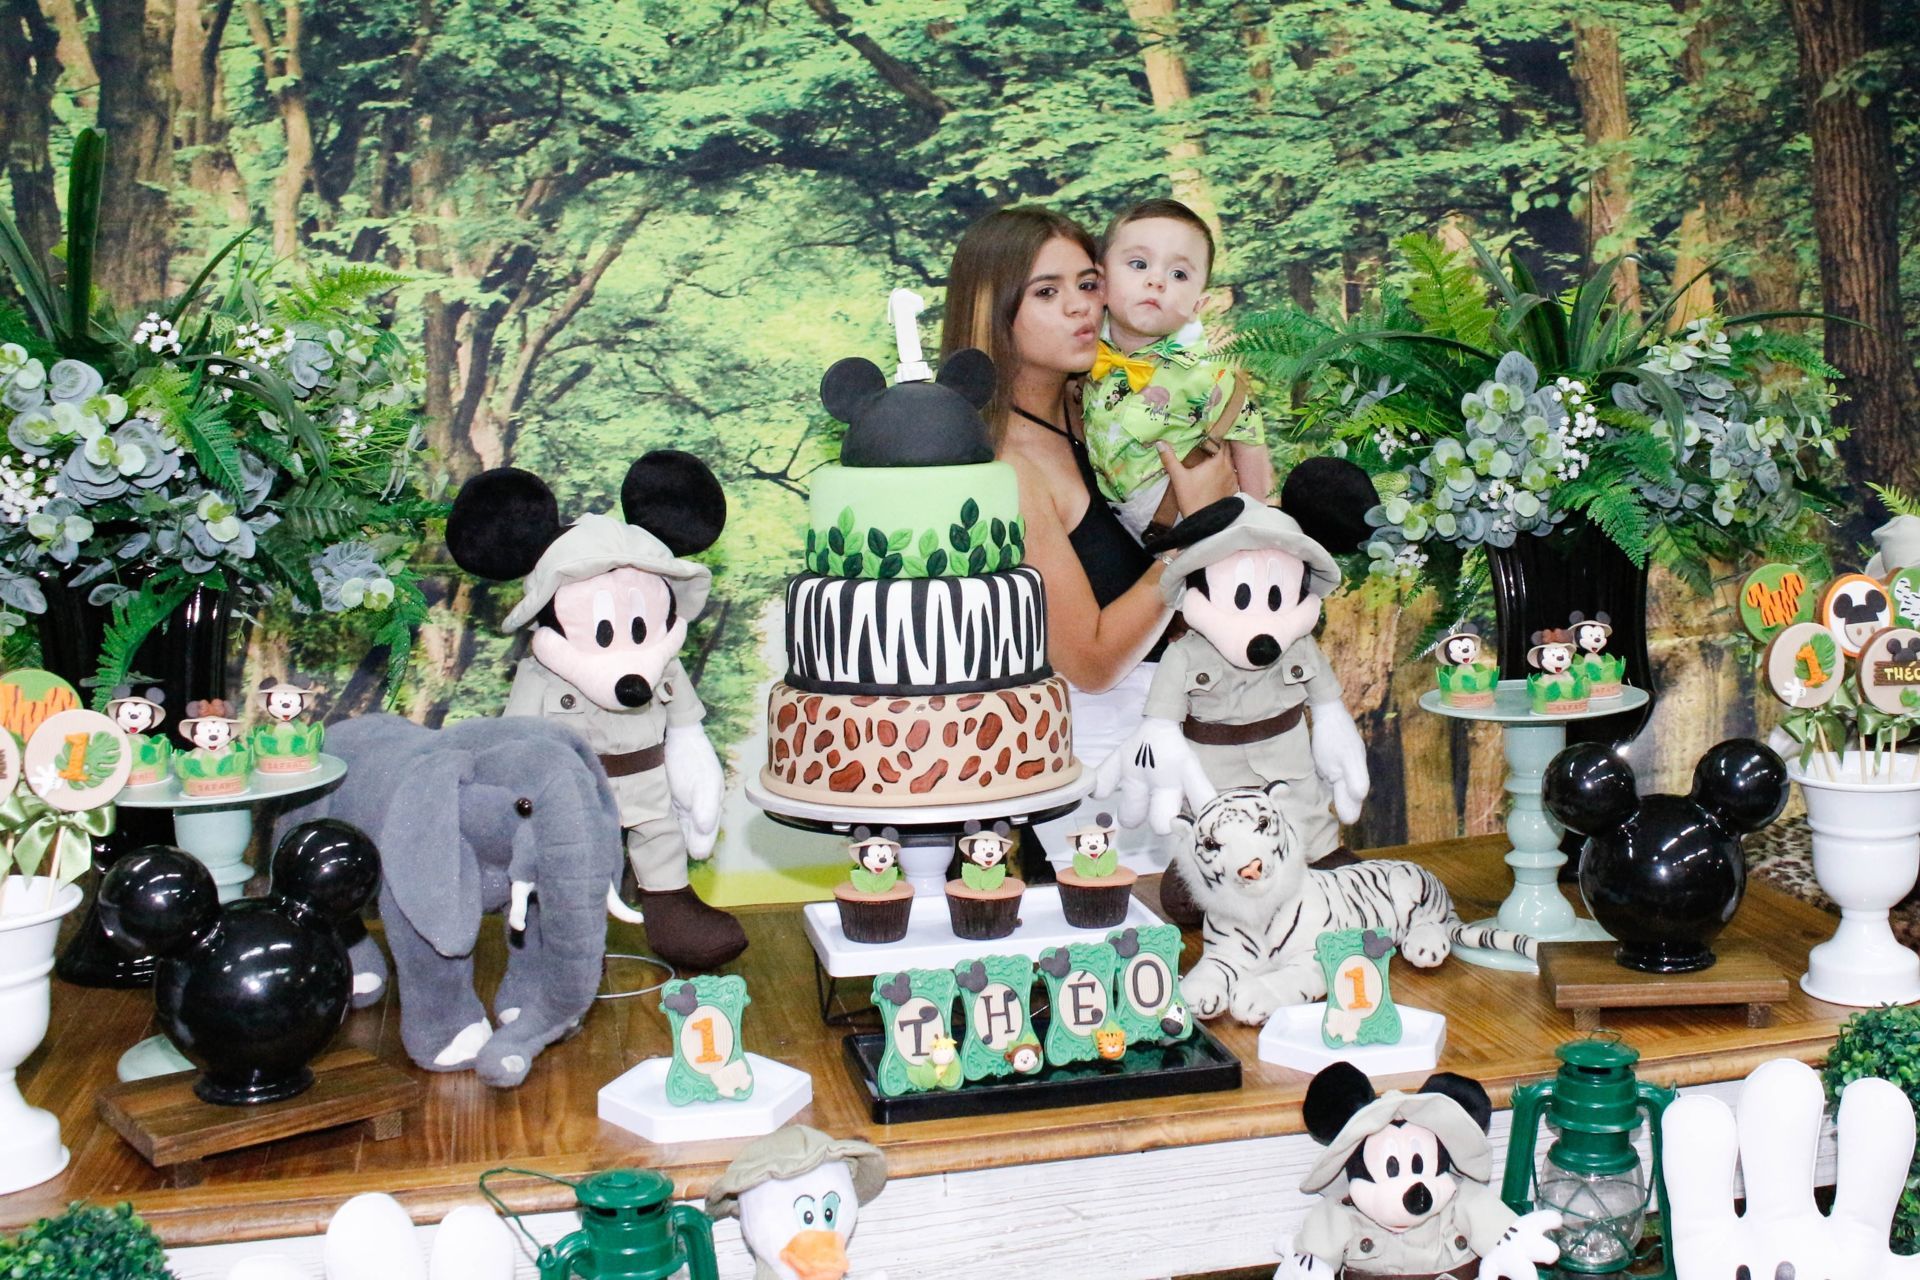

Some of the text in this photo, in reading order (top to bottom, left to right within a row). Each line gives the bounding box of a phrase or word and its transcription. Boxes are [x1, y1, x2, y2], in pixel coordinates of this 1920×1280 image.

[1795, 645, 1829, 688] 1
[58, 732, 90, 782] 1
[1344, 966, 1373, 1010] 1
[691, 1017, 724, 1064] 1
